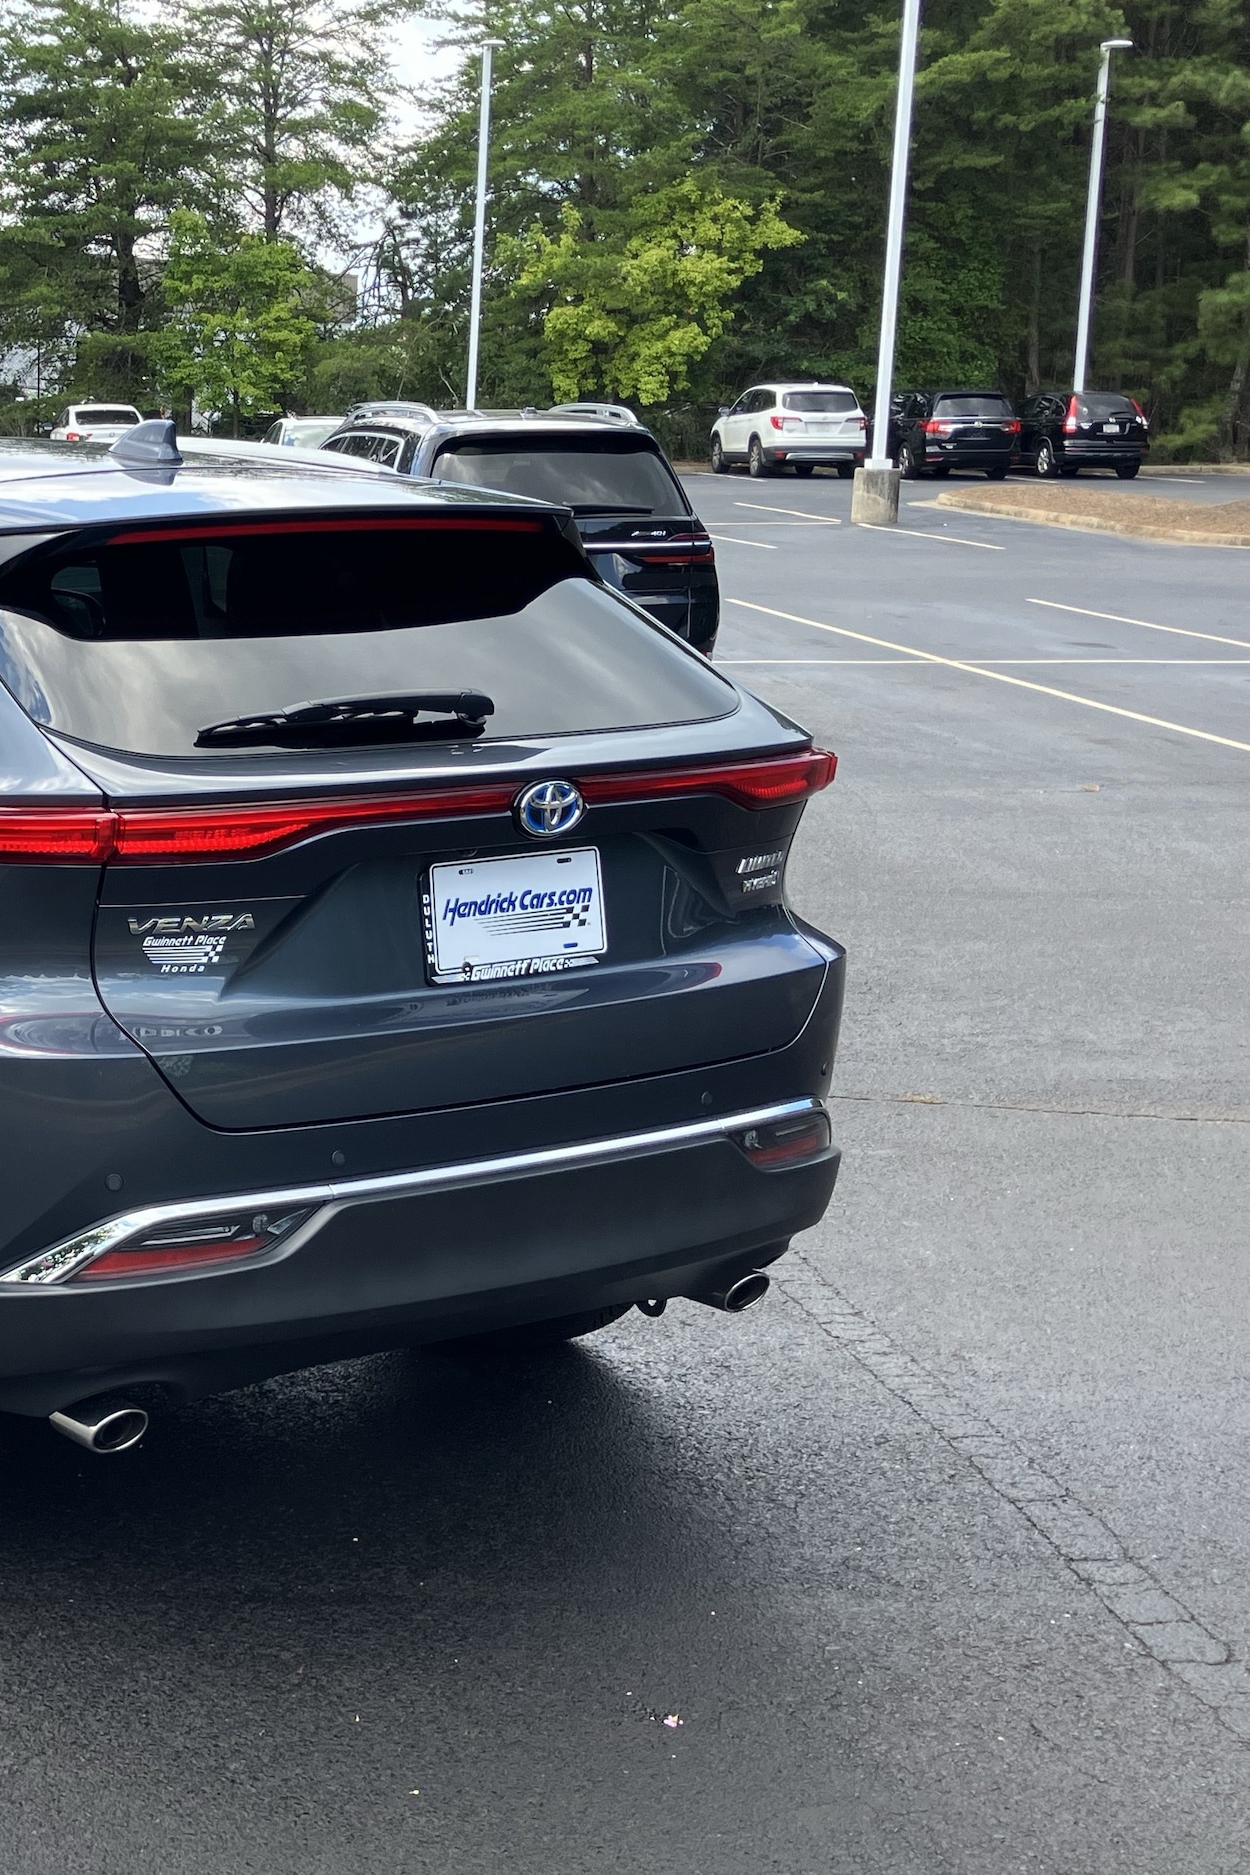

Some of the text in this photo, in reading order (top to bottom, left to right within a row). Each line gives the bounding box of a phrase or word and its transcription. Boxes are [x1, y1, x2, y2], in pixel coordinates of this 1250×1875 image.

[128, 913, 256, 935] VENZA
[422, 894, 435, 964] DULUTH
[142, 935, 227, 947] Gwinnett Place
[161, 964, 205, 973] Honda
[471, 957, 565, 981] Gwinnett Place
